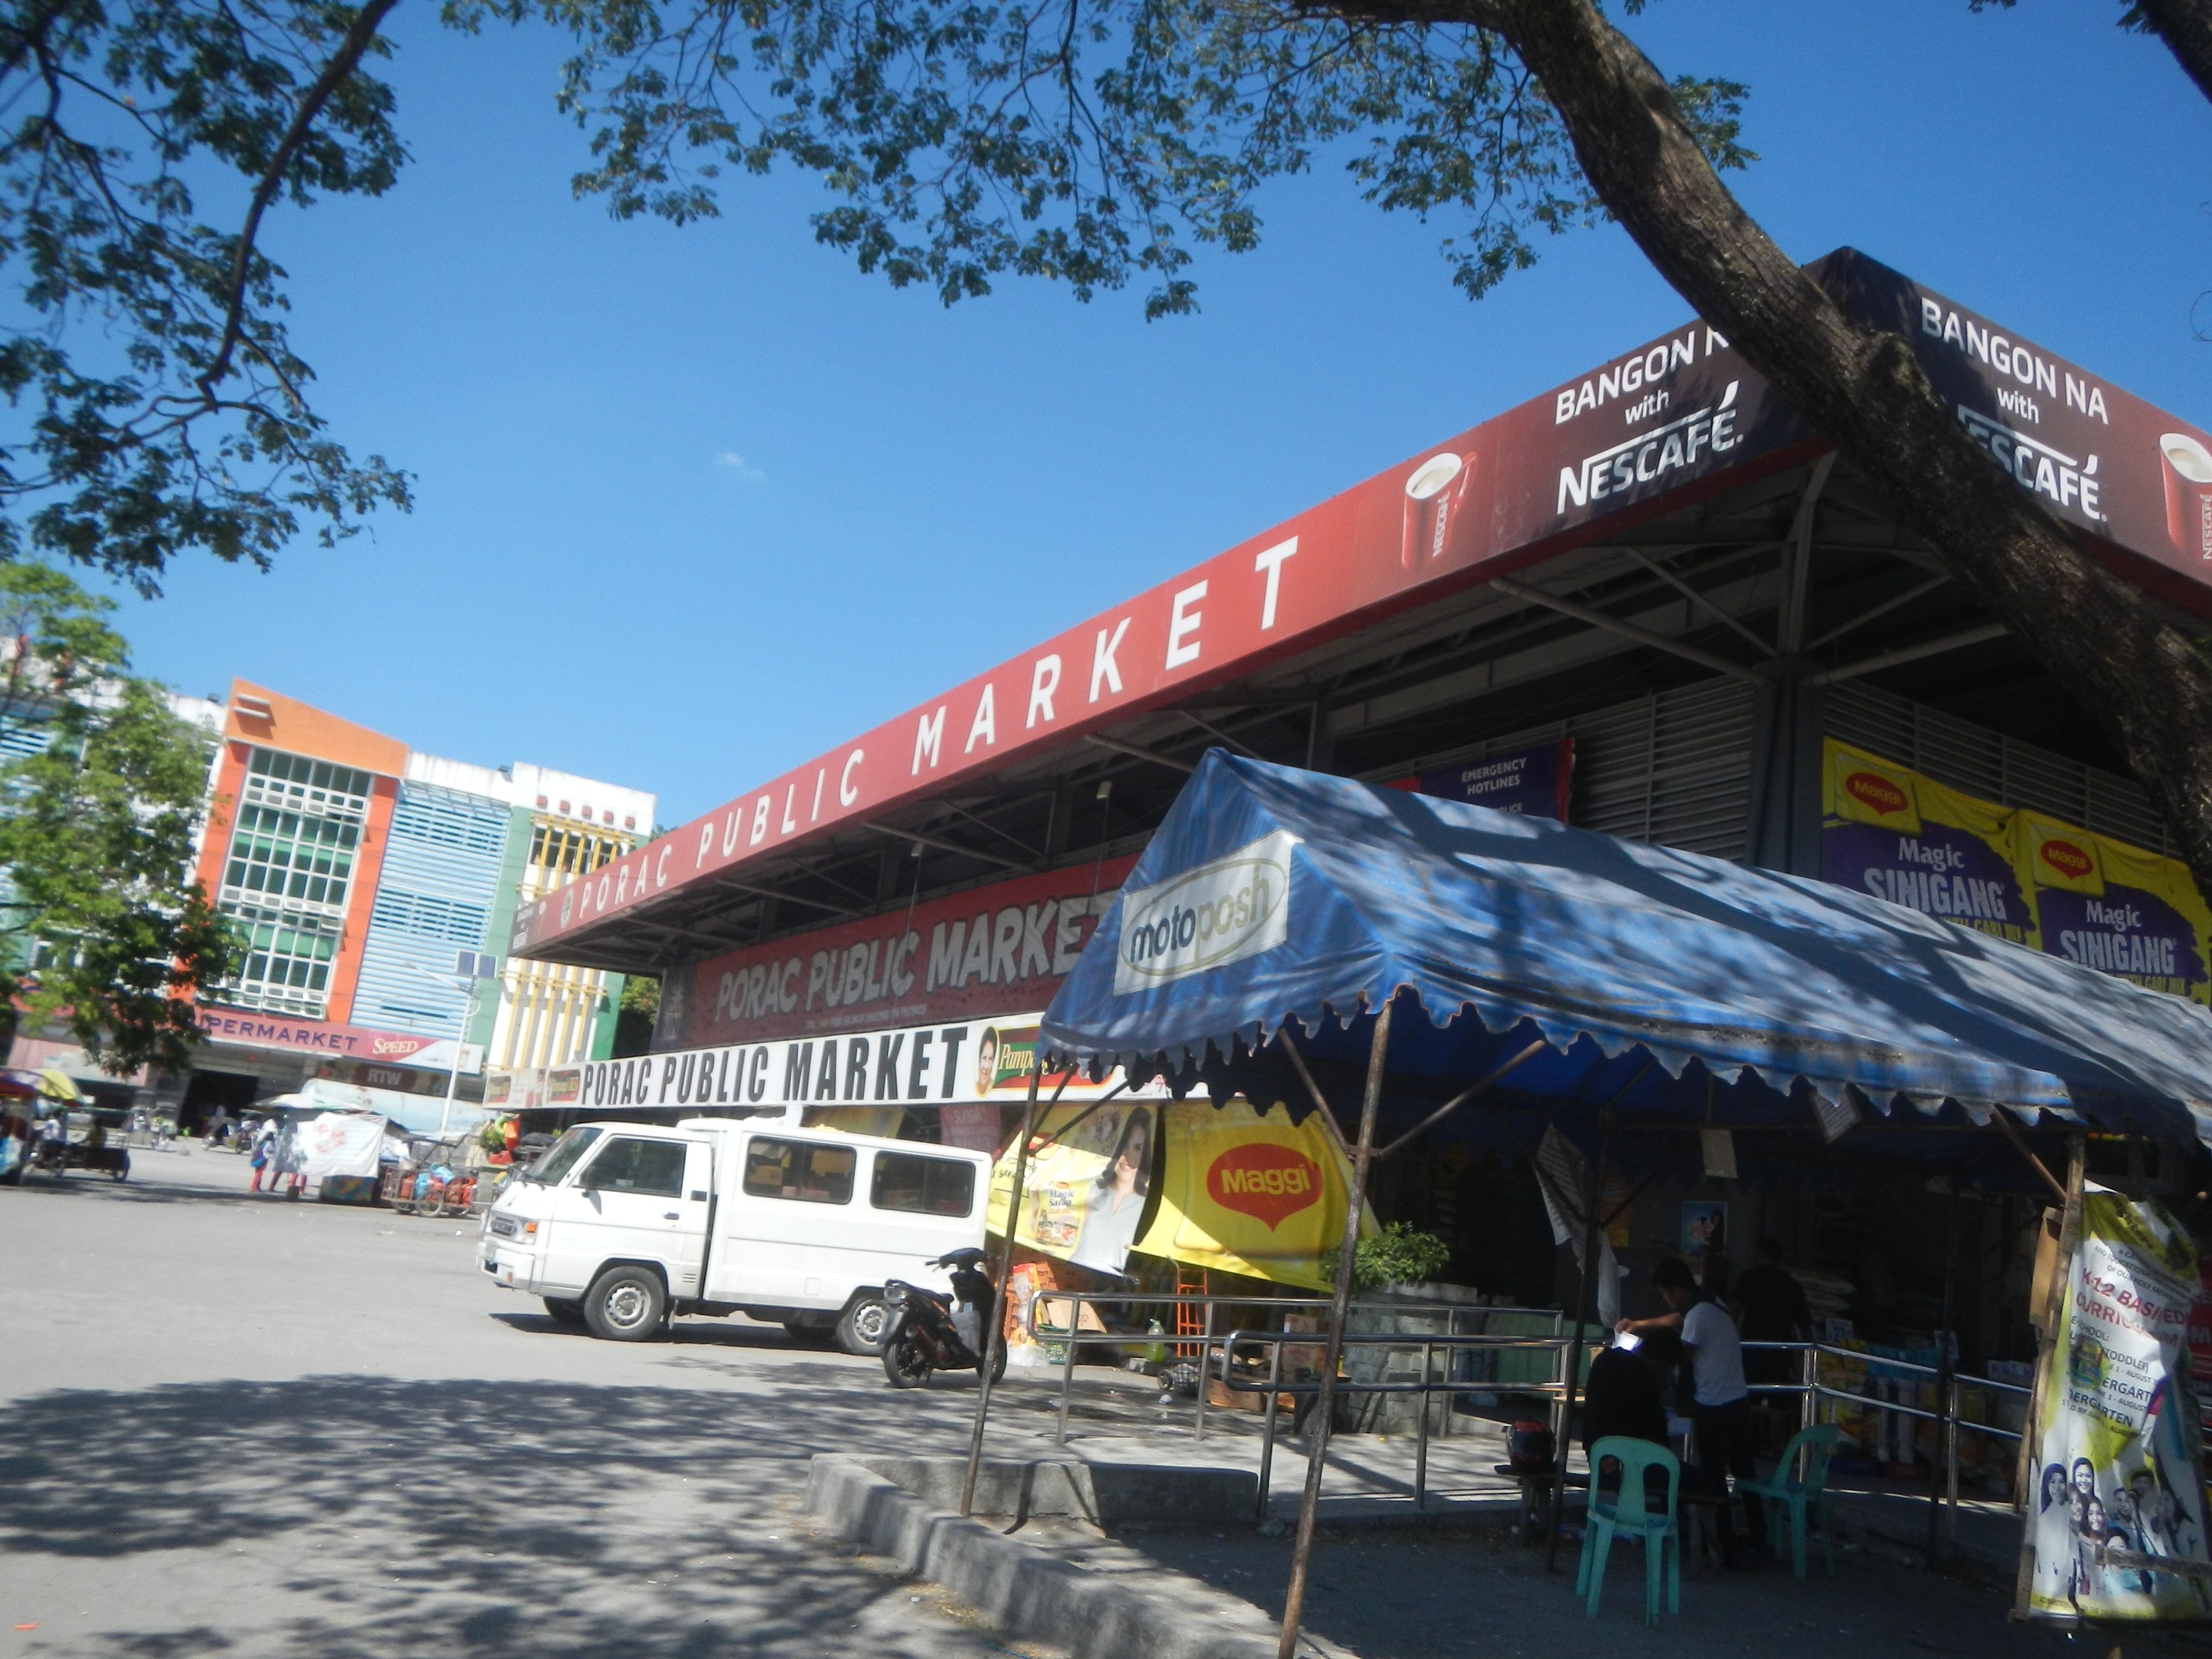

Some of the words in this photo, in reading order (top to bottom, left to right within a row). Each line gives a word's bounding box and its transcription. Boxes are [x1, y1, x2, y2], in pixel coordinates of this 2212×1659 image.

[1555, 329, 1696, 425] BANGON
[1922, 296, 2057, 398] BANGON
[2065, 373, 2109, 425] NA
[1624, 389, 1669, 424] with
[1998, 387, 2040, 423] with
[1958, 404, 2101, 520] ESCAFÉ
[579, 843, 672, 919] PORAC
[695, 748, 865, 869] PUBLIC
[911, 535, 1299, 776] MARKET
[1462, 757, 1526, 782] EMERGENCY
[1467, 774, 1520, 796] HOTLINES
[1853, 780, 1902, 806] Maggi
[1899, 836, 1965, 873] Magic
[2047, 848, 2088, 869] Maggi
[1864, 867, 2008, 920] SINIGANG
[1131, 863, 1270, 962] motoposh
[2087, 899, 2141, 932] Magic
[2060, 929, 2174, 975] SINIGANG
[714, 956, 802, 1024] PORAC
[806, 929, 920, 1011] PUBLIC
[367, 1068, 403, 1085] RTW
[581, 1059, 650, 1106] PORAC
[659, 1045, 770, 1104] PUBLIC
[783, 1025, 969, 1101] MARKET
[1049, 1189, 1075, 1201] Magic
[1220, 1163, 1312, 1196] Maggi
[1048, 1199, 1072, 1207] Sarap
[2082, 1267, 2115, 1298] K-12
